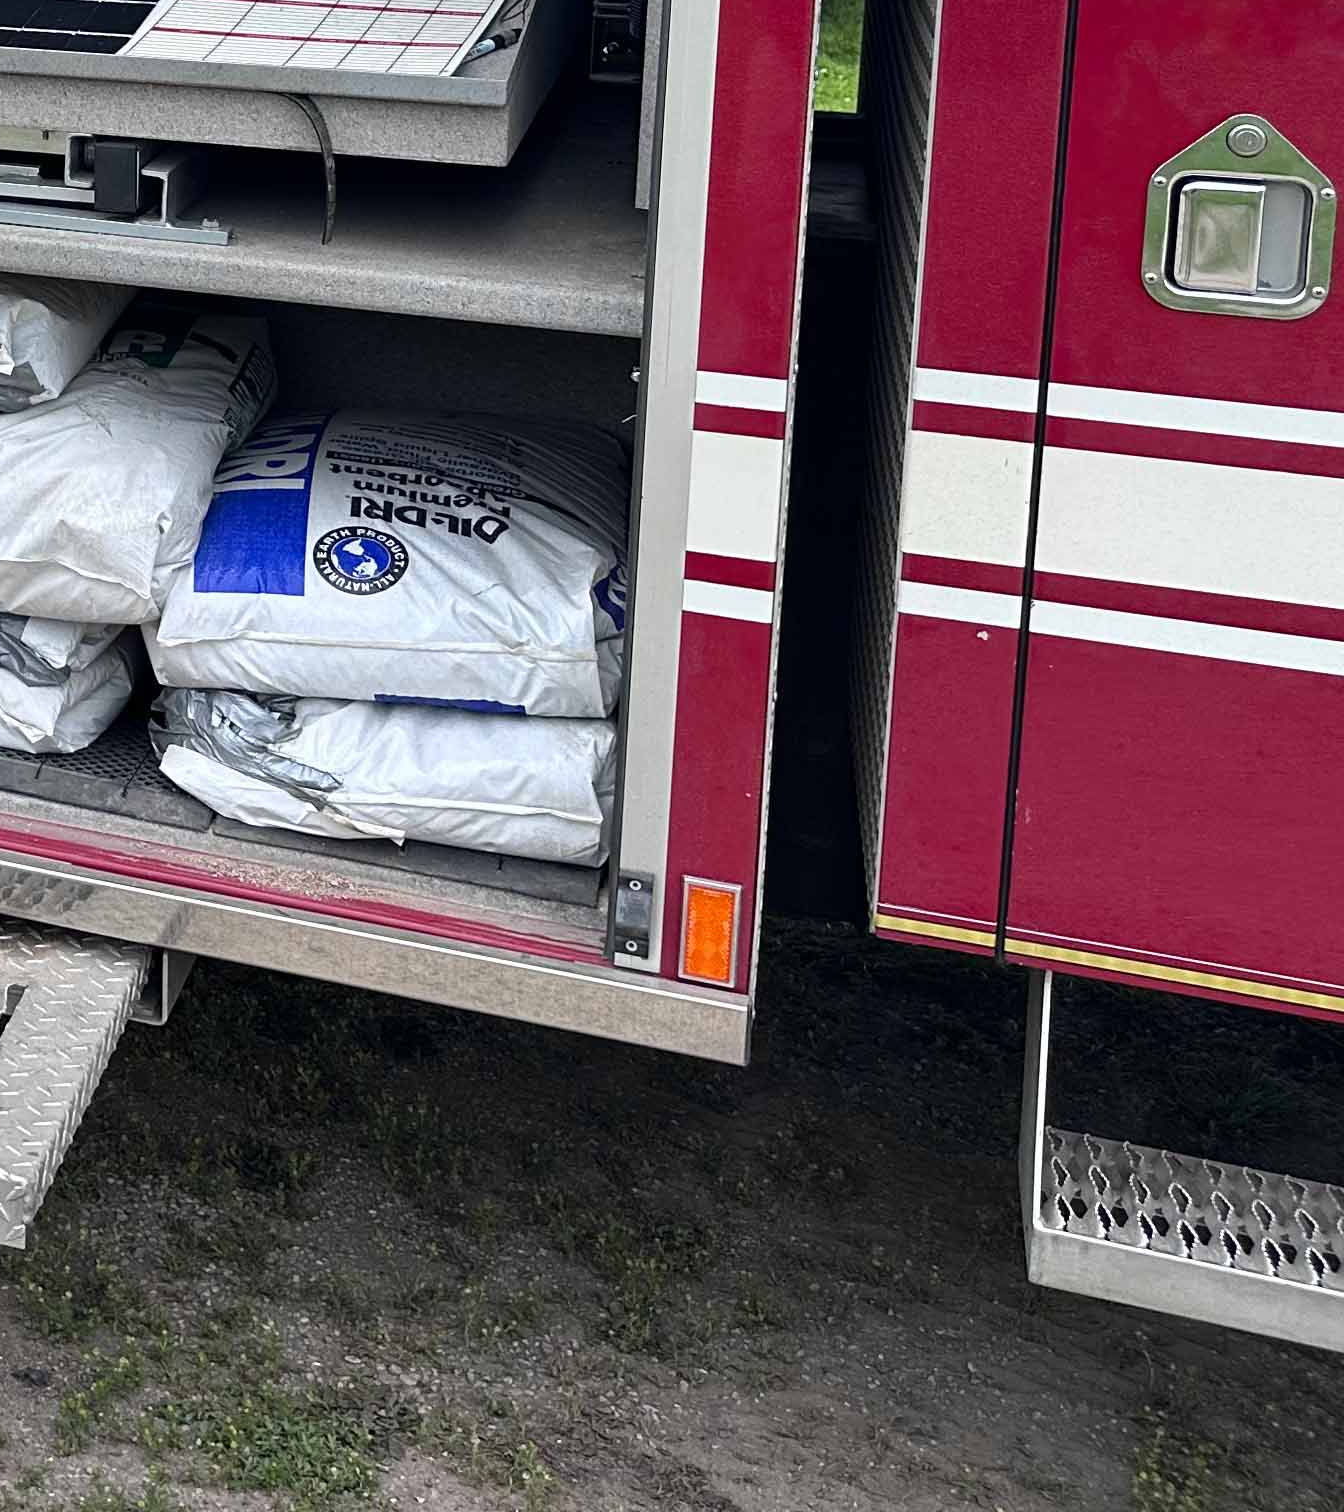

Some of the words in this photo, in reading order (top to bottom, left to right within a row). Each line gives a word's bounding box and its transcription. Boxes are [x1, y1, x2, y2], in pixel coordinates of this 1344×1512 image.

[353, 480, 511, 519] Premium
[316, 528, 351, 558] EARTH
[356, 528, 405, 568] PRODUCT
